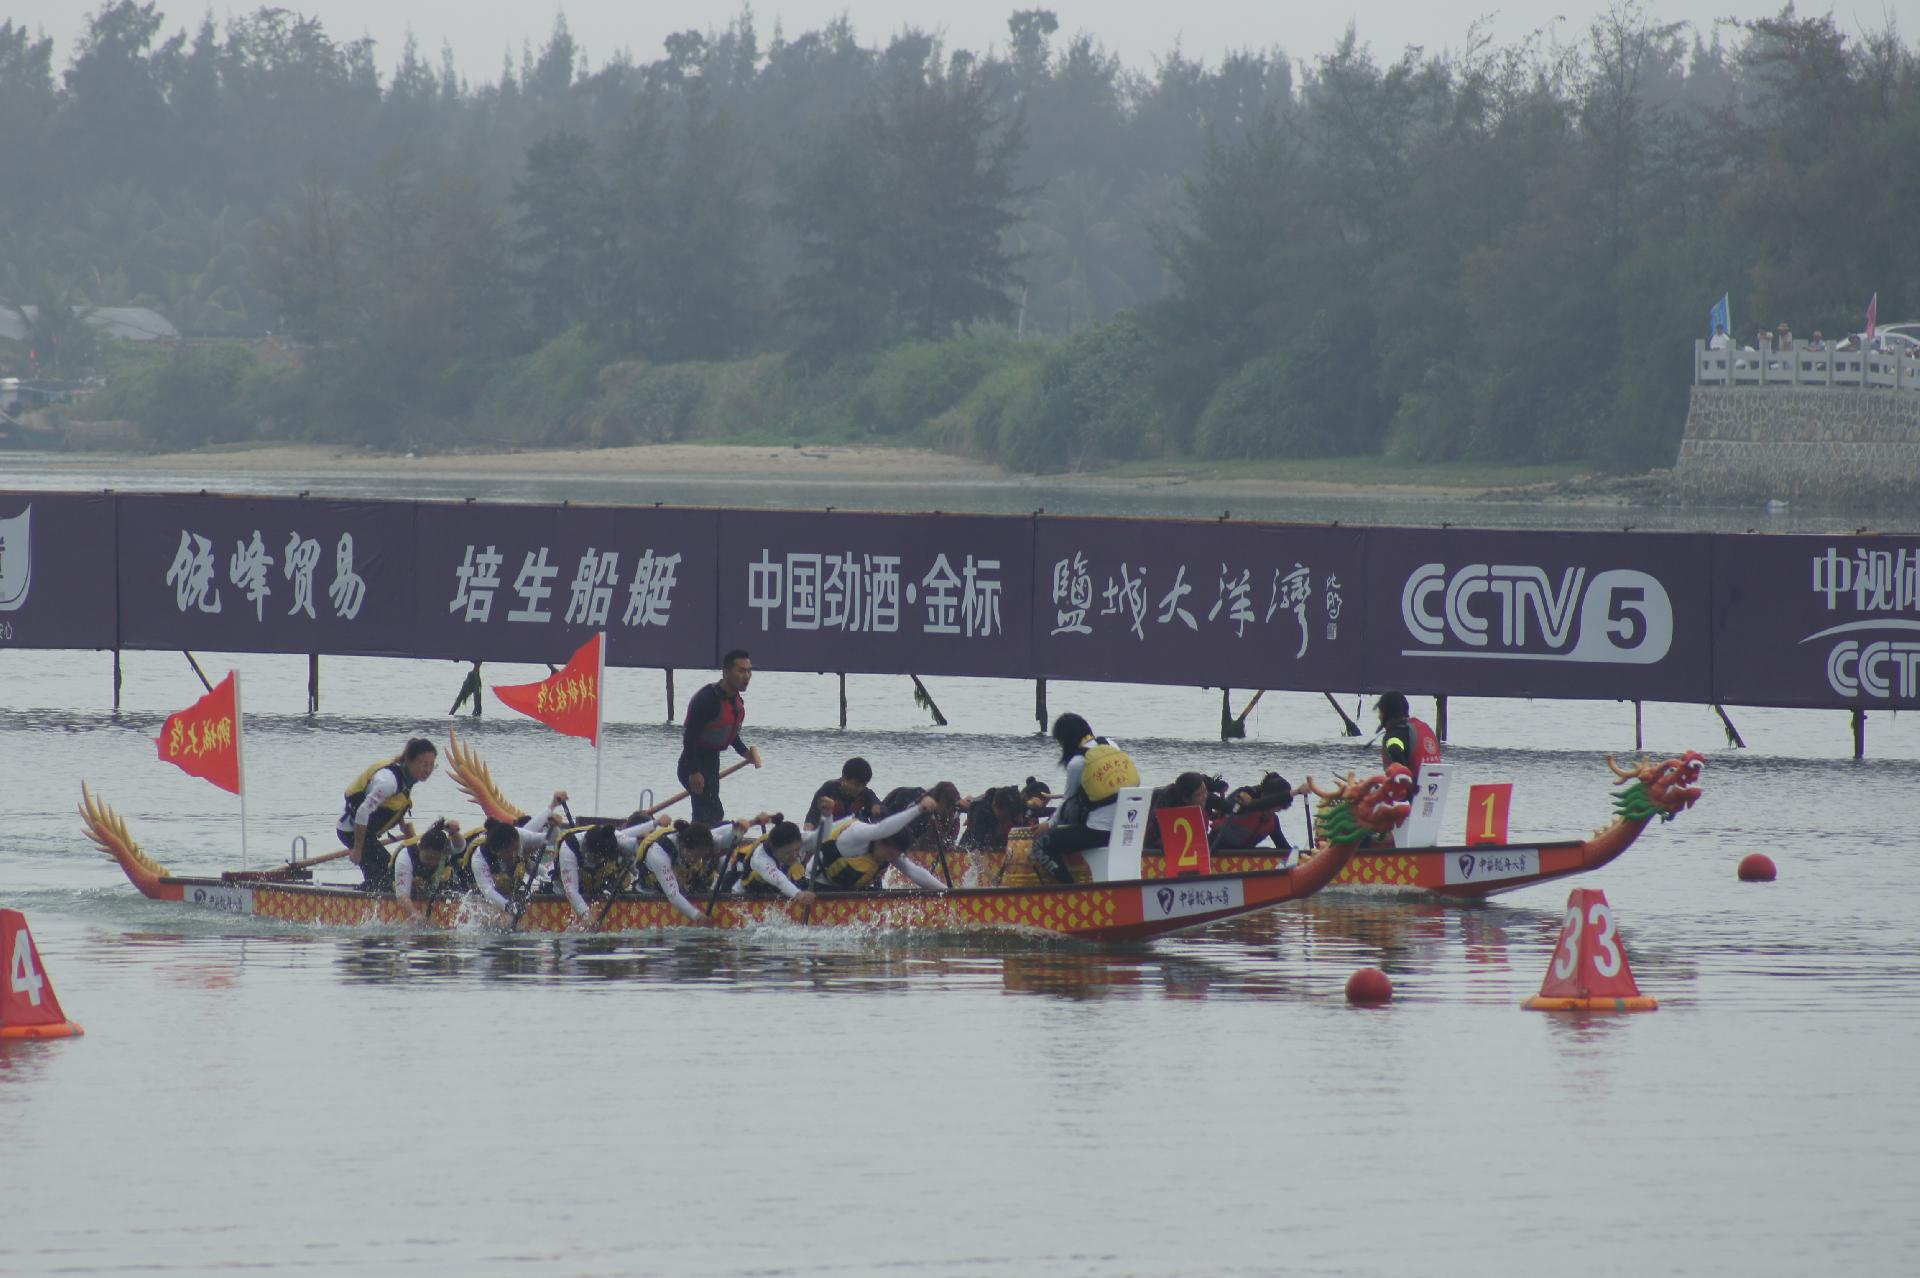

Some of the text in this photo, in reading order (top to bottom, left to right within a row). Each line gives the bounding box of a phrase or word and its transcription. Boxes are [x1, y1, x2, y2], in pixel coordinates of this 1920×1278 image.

[450, 545, 682, 626] 培生船艇
[1402, 563, 1648, 650] CCTV 5
[1173, 817, 1198, 867] 2
[1480, 792, 1496, 838] 1
[11, 929, 43, 1006] 4
[1554, 906, 1583, 980] 3
[1588, 903, 1622, 978] 3
